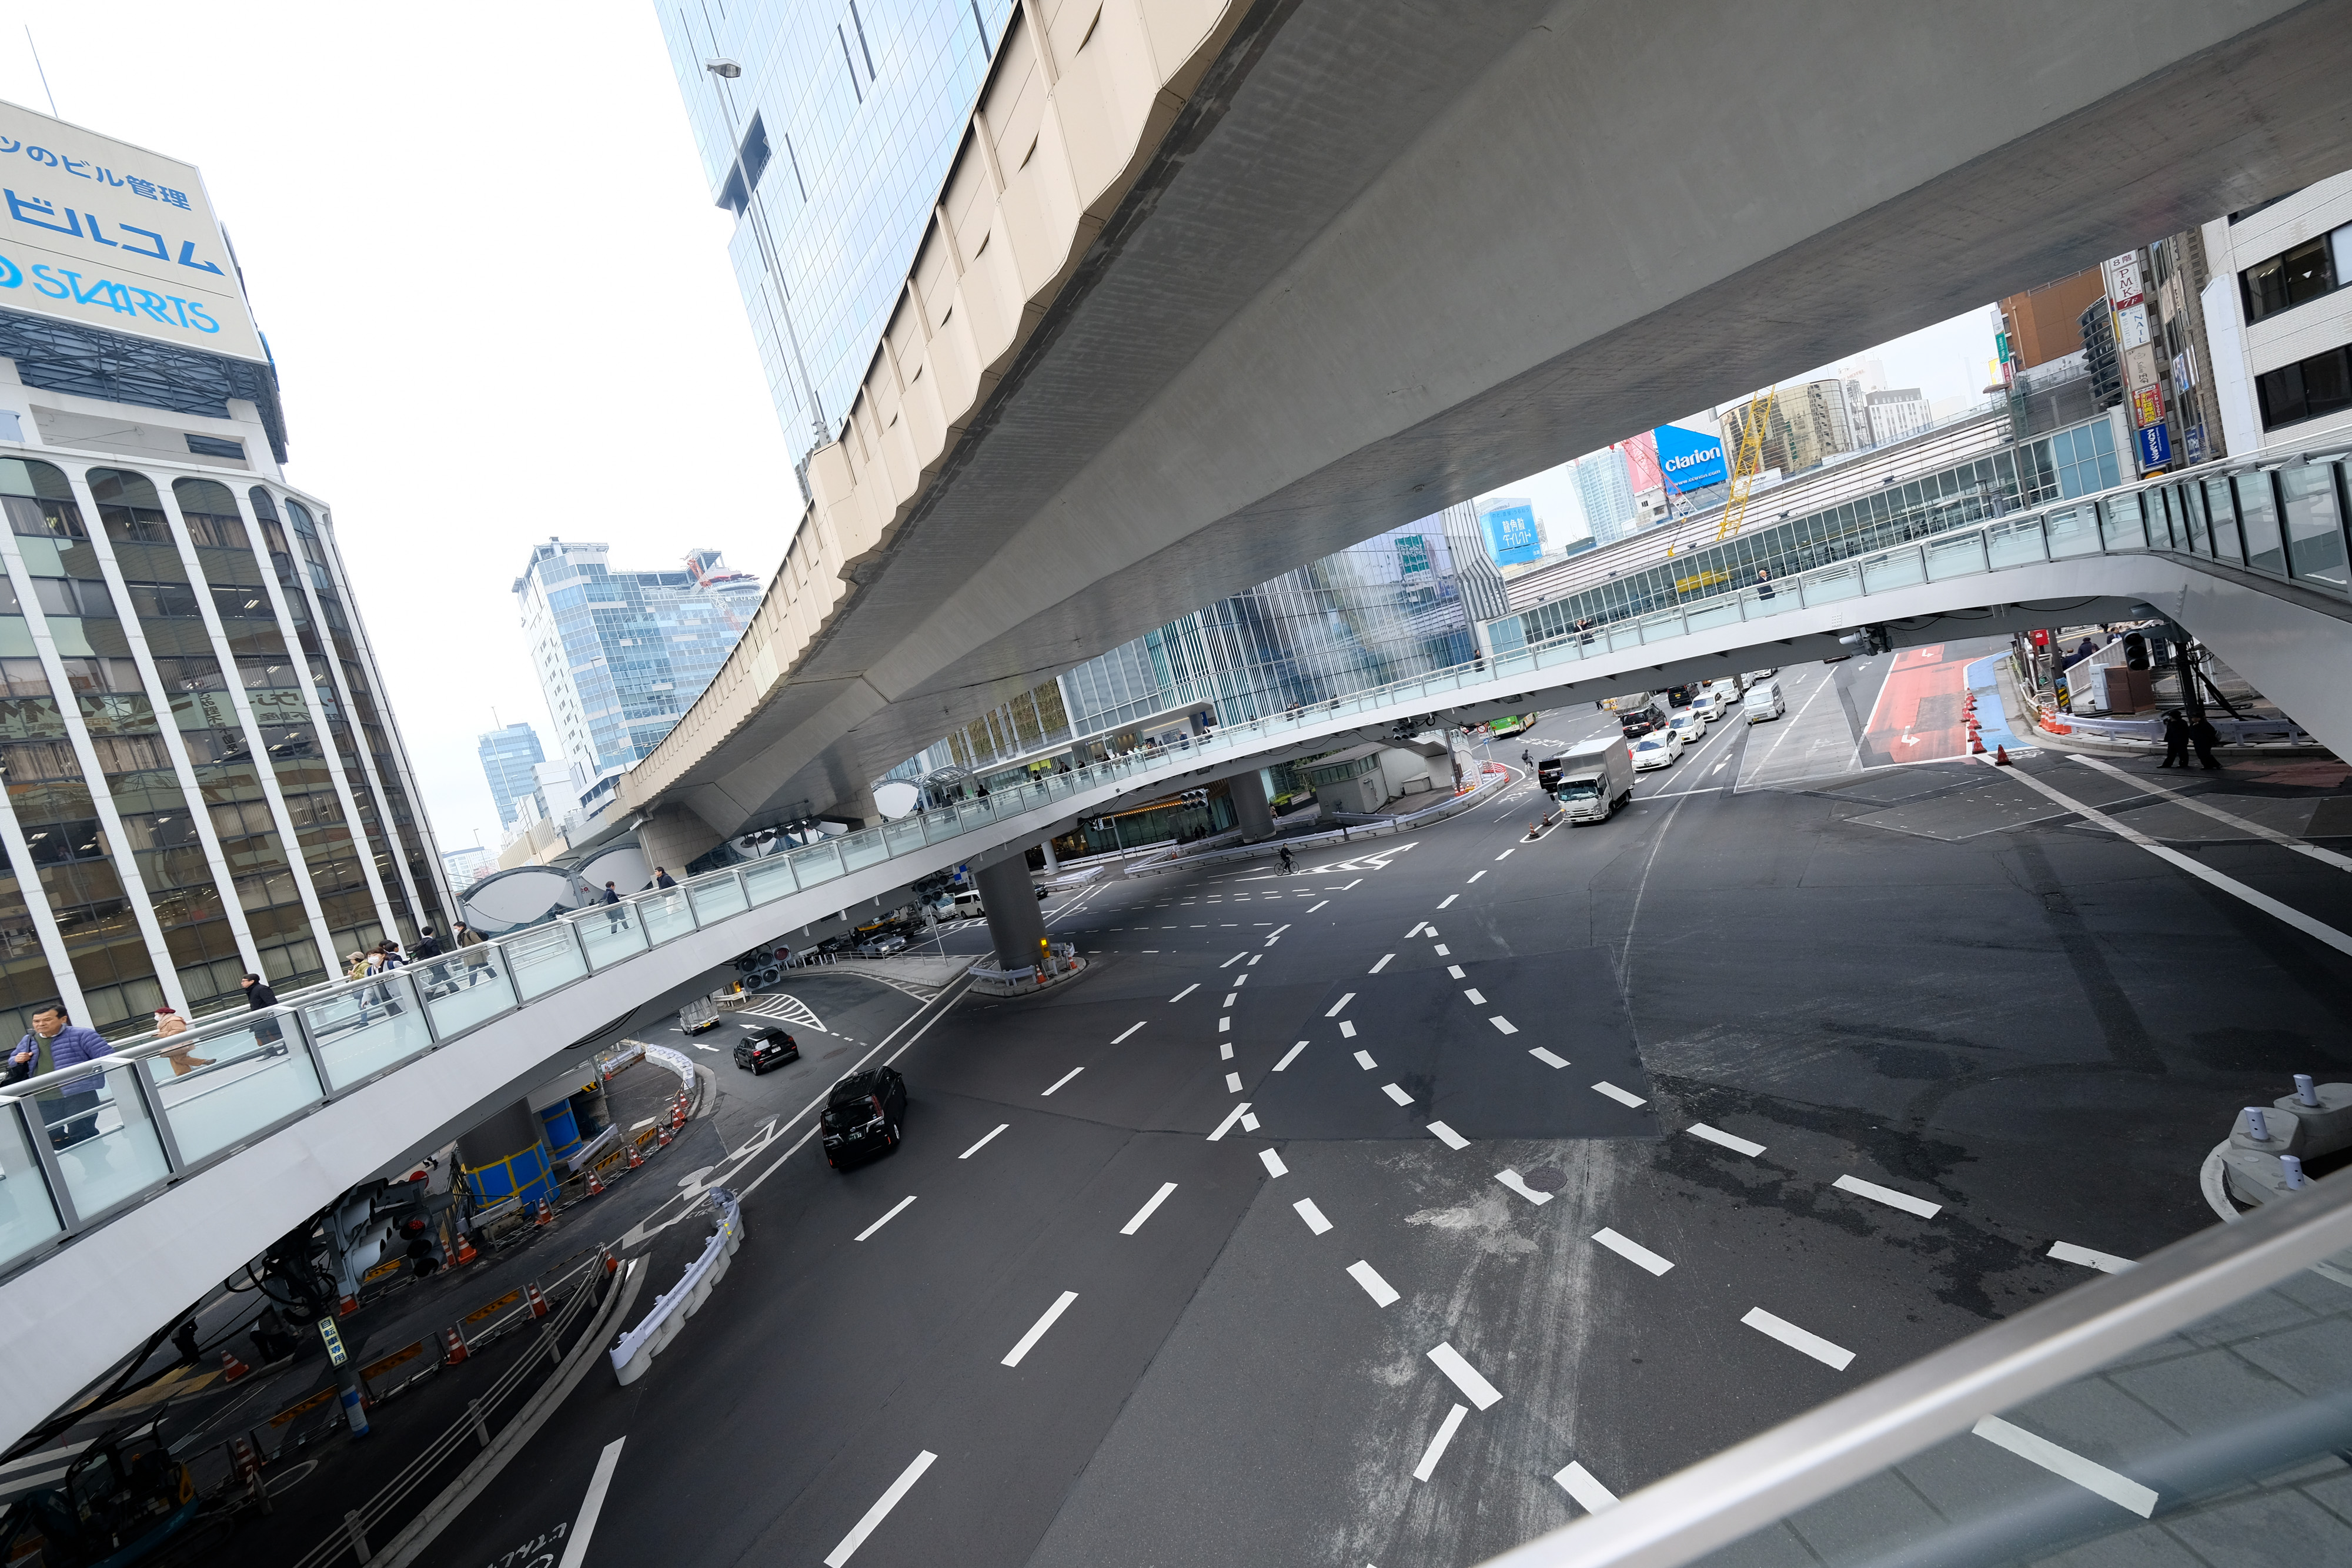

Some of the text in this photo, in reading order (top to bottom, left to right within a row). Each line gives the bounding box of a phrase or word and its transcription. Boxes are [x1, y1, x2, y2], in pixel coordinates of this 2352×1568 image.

[3, 188, 225, 276] ビルコム
[2113, 254, 2132, 266] 8階
[2119, 268, 2134, 298] PMK
[32, 264, 220, 333] STARTS
[2123, 297, 2137, 307] 7F
[2134, 313, 2147, 343] NAIL
[1502, 517, 1526, 533] 龍角散
[1503, 530, 1531, 547] ダイレクト
[2154, 638, 2166, 663] 転車専用
[321, 1319, 345, 1364] 自転車専用
